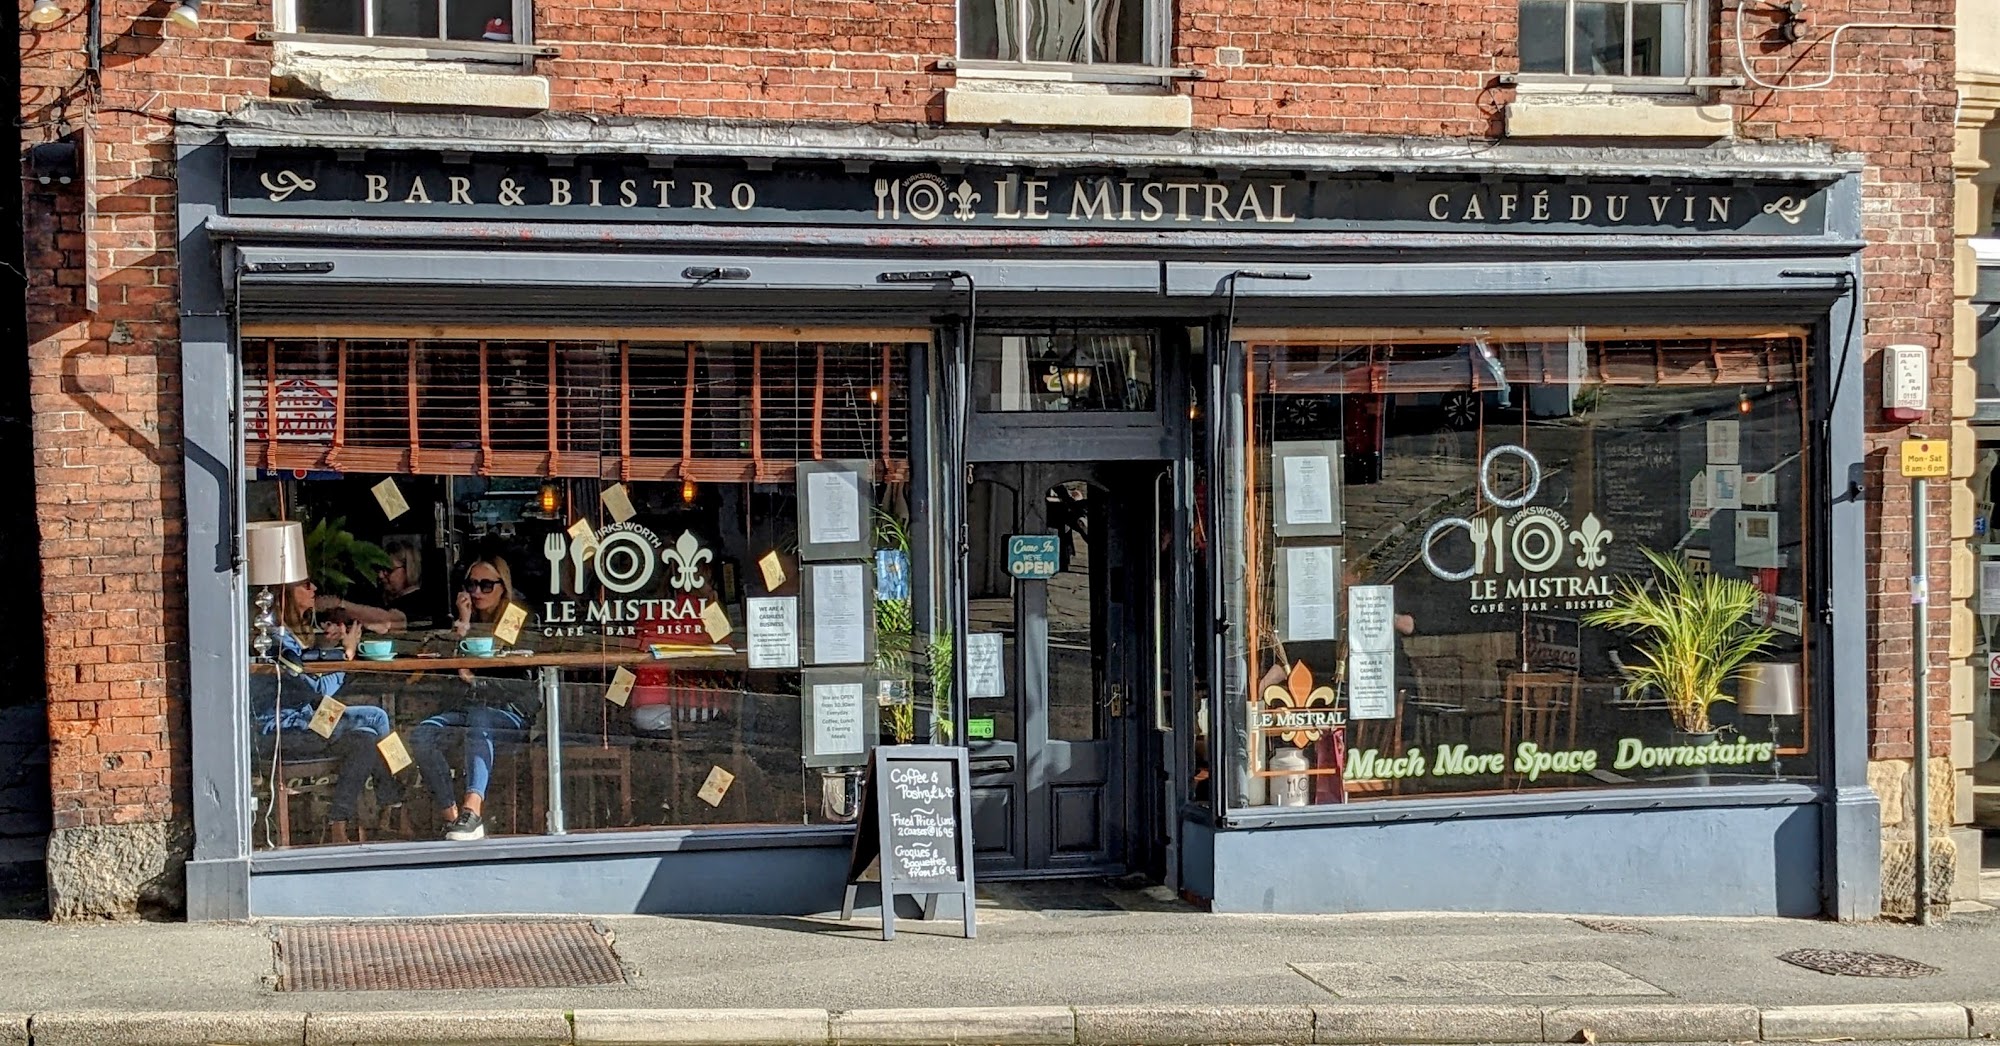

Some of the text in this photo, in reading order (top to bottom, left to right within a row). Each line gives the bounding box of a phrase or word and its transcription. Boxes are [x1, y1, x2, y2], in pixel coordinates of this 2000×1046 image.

[902, 173, 949, 191] WIRKSWORTH
[365, 174, 757, 211] BAR & BISTRO
[993, 180, 1296, 223] LE MISTRAL
[1429, 189, 1732, 223] CAFÉ DU VIN
[1506, 506, 1570, 531] WIRKSWORTH
[1013, 539, 1055, 554] Come In
[1012, 561, 1055, 574] OPEN
[1470, 576, 1614, 600] LE MISTRAL
[544, 601, 576, 622] LE
[1470, 602, 1504, 613] CAFÉ
[1522, 602, 1547, 612] BAR
[1565, 600, 1614, 610] BISTRO
[544, 626, 584, 637] CAFÉ
[606, 626, 636, 636] BAR
[657, 625, 709, 635] BISTR
[1253, 712, 1346, 727] LE MISTRAL
[1343, 735, 1774, 782] Much More Space Downstairs
[890, 768, 929, 785] Coffee
[891, 812, 914, 827] Fixed
[913, 814, 936, 827] Price
[895, 845, 931, 859] Croques
[908, 866, 931, 878] from
